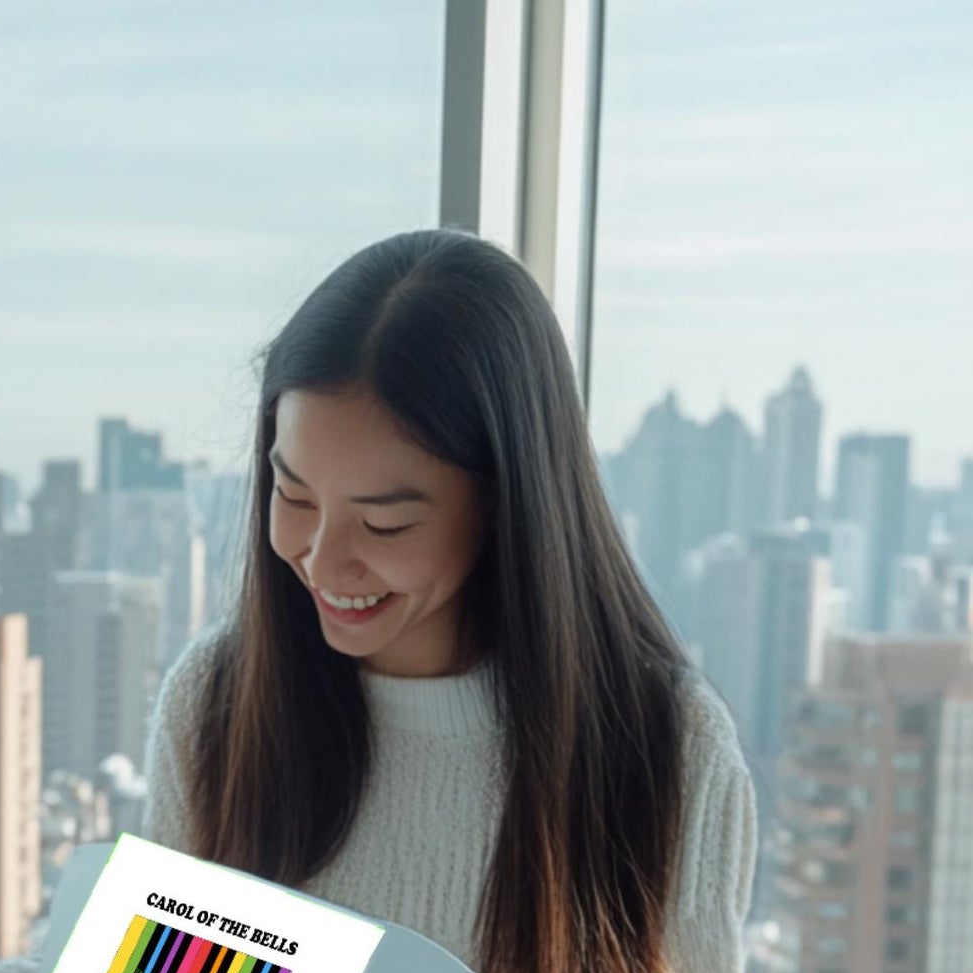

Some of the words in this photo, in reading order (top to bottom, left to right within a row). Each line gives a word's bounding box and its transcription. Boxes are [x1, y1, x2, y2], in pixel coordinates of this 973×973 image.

[146, 892, 195, 921] CAROL
[196, 910, 219, 927] OF
[219, 916, 250, 940] THE
[249, 929, 299, 956] BELLS
